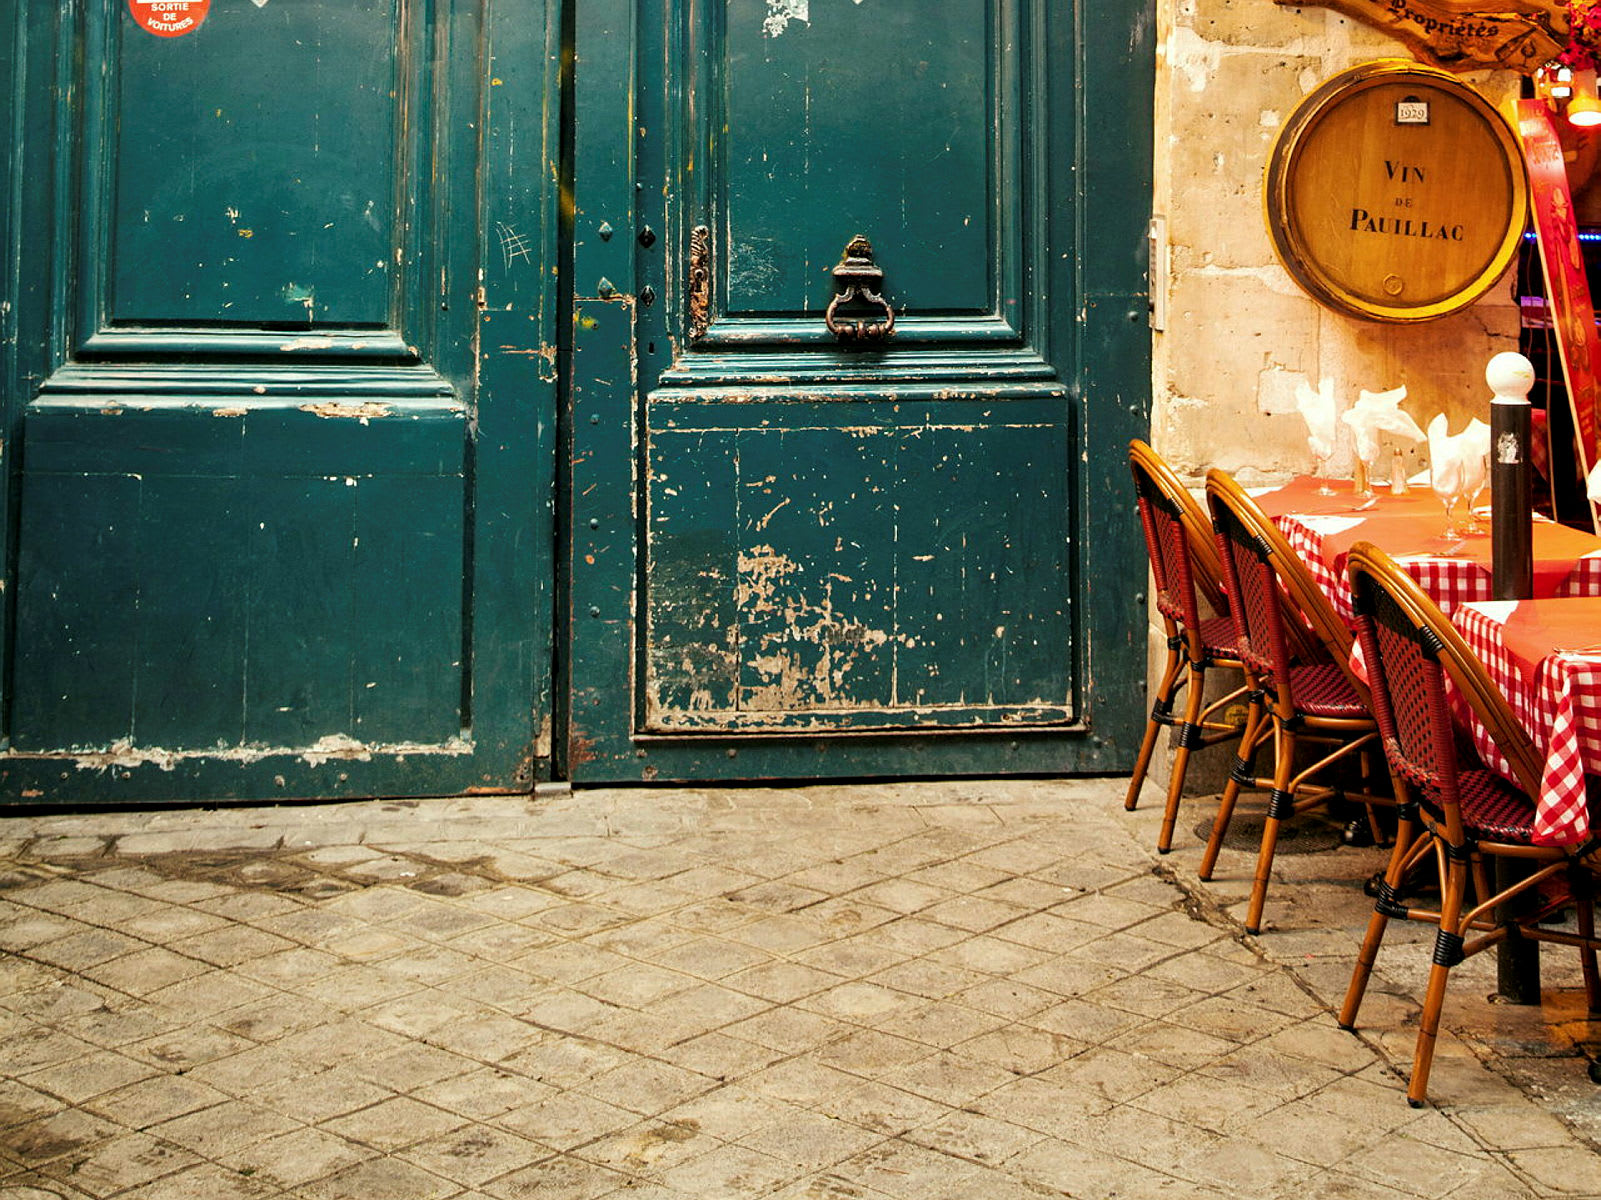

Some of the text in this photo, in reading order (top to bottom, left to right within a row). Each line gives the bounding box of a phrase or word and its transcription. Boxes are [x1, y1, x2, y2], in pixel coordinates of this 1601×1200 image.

[151, 2, 190, 12] SORTIE
[162, 12, 177, 21] DE
[147, 16, 194, 32] VOITURES
